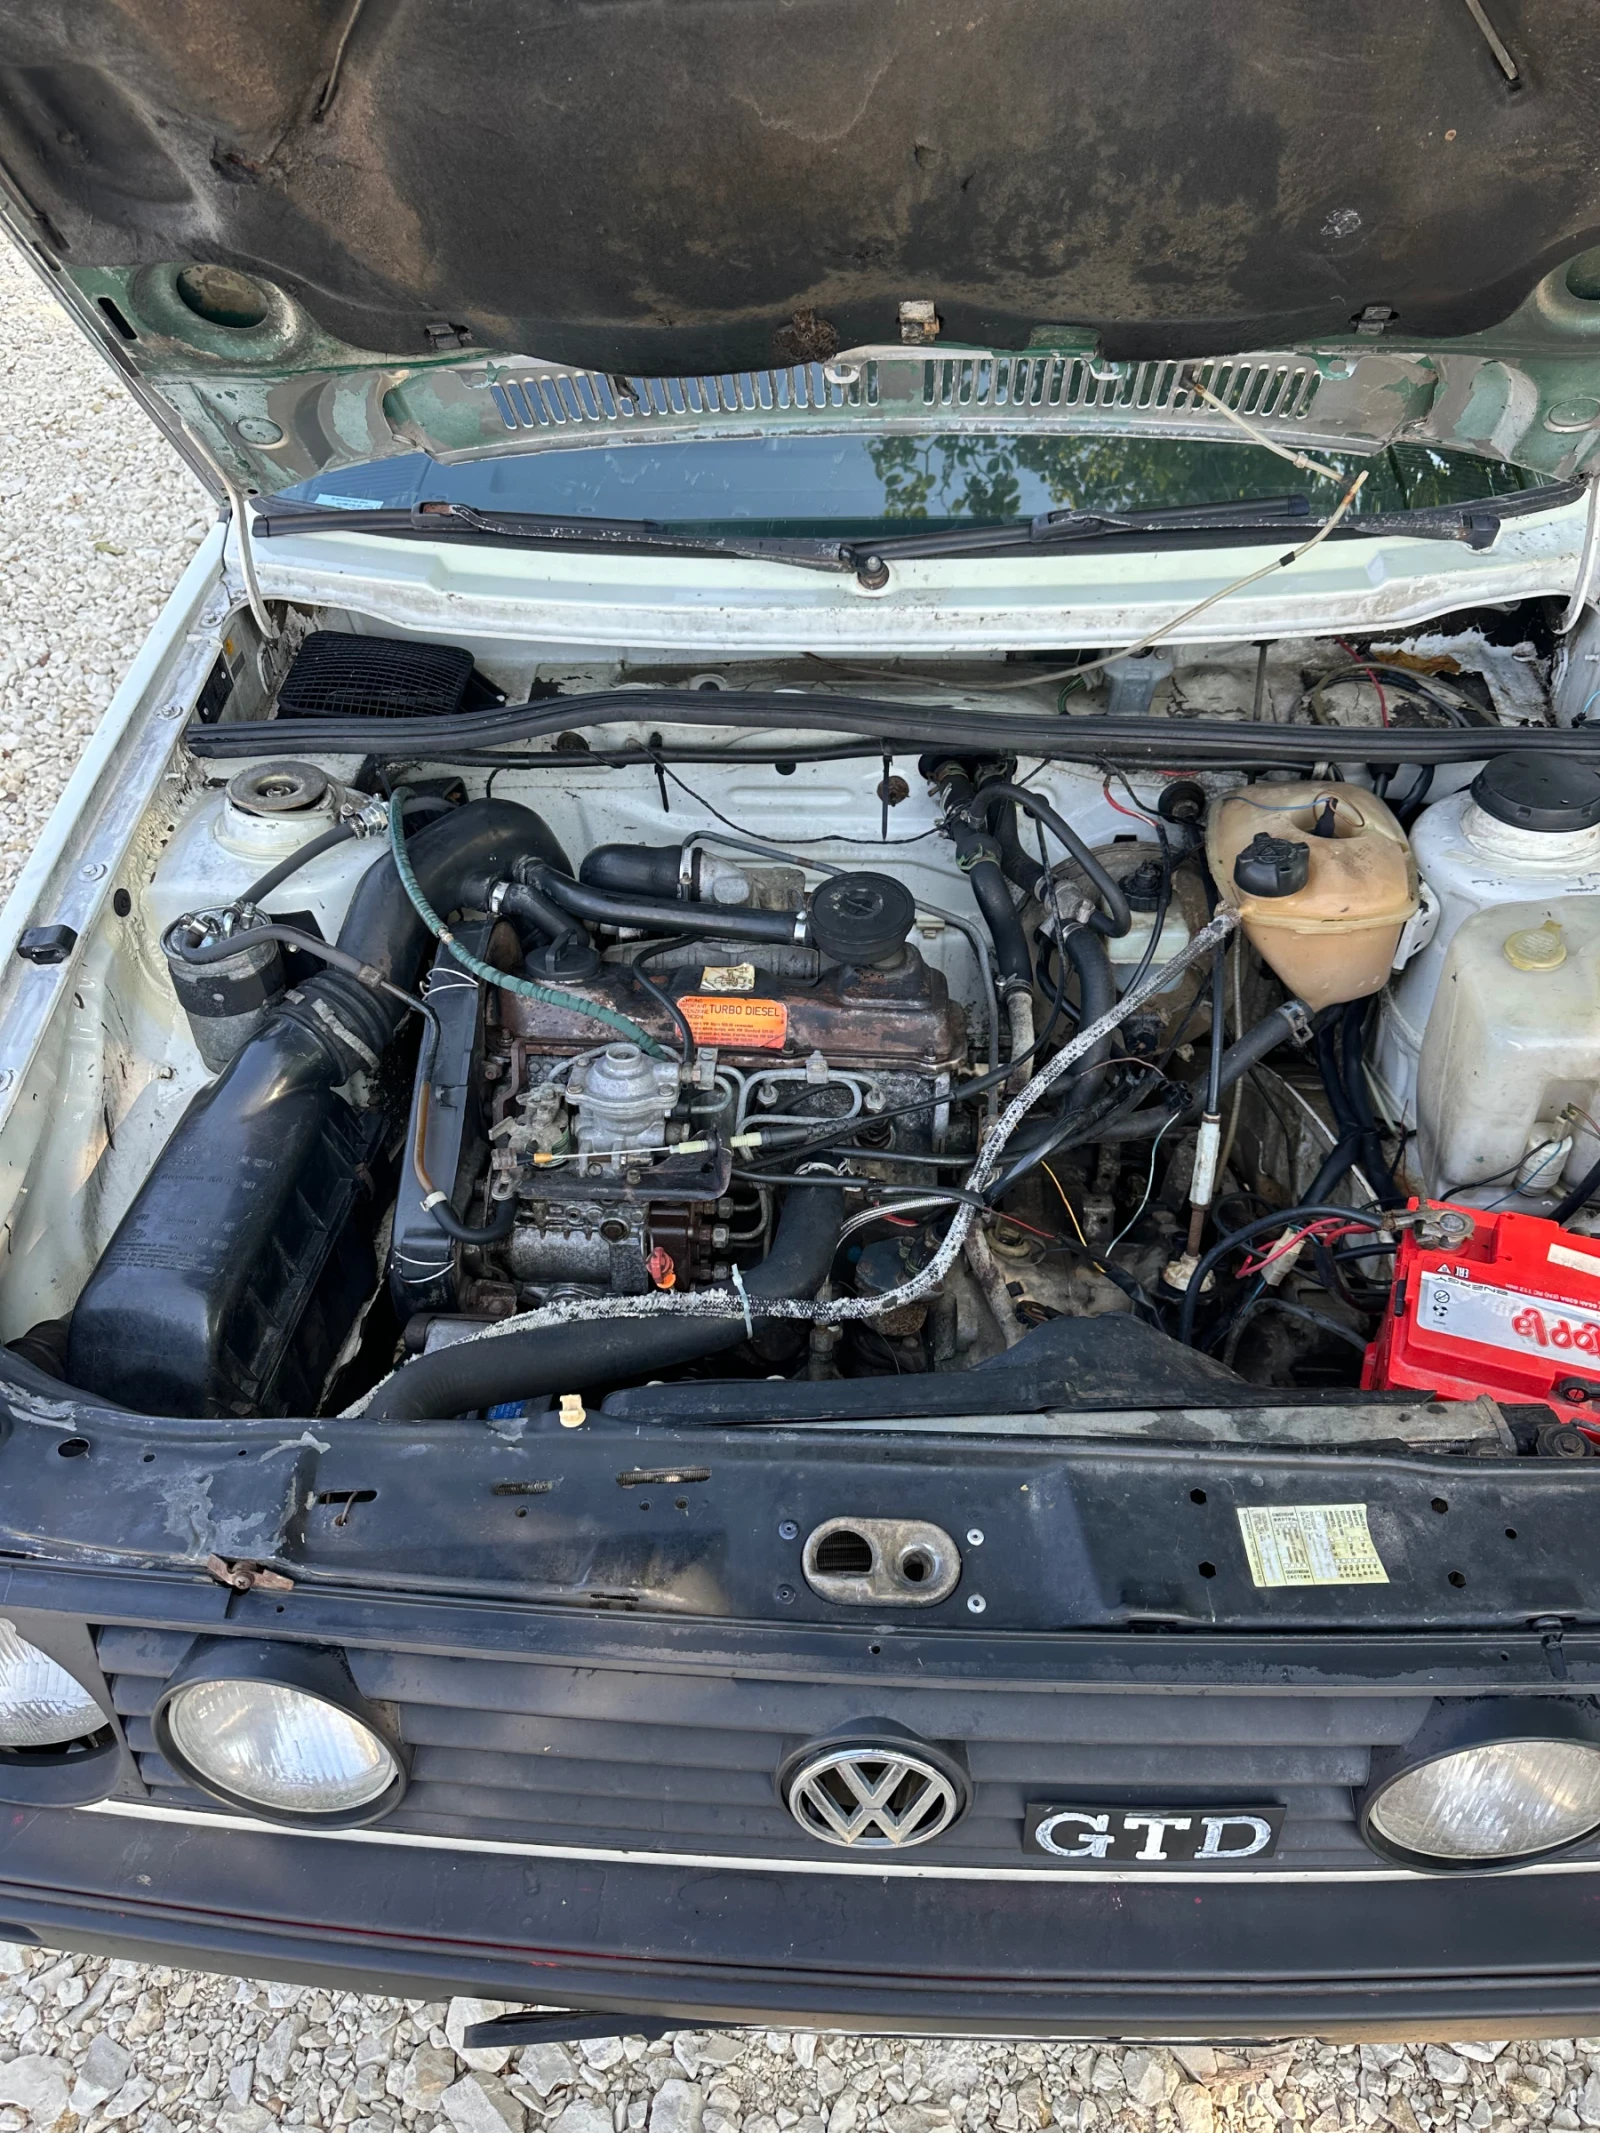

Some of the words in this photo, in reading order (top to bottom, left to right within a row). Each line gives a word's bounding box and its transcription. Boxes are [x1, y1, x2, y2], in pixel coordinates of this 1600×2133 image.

[709, 1004, 743, 1015] TURBO
[745, 1005, 780, 1017] DIESEL
[1435, 1276, 1508, 1296] ENERGY
[1532, 1289, 1543, 1297] RC
[1035, 1812, 1271, 1860] GTD
